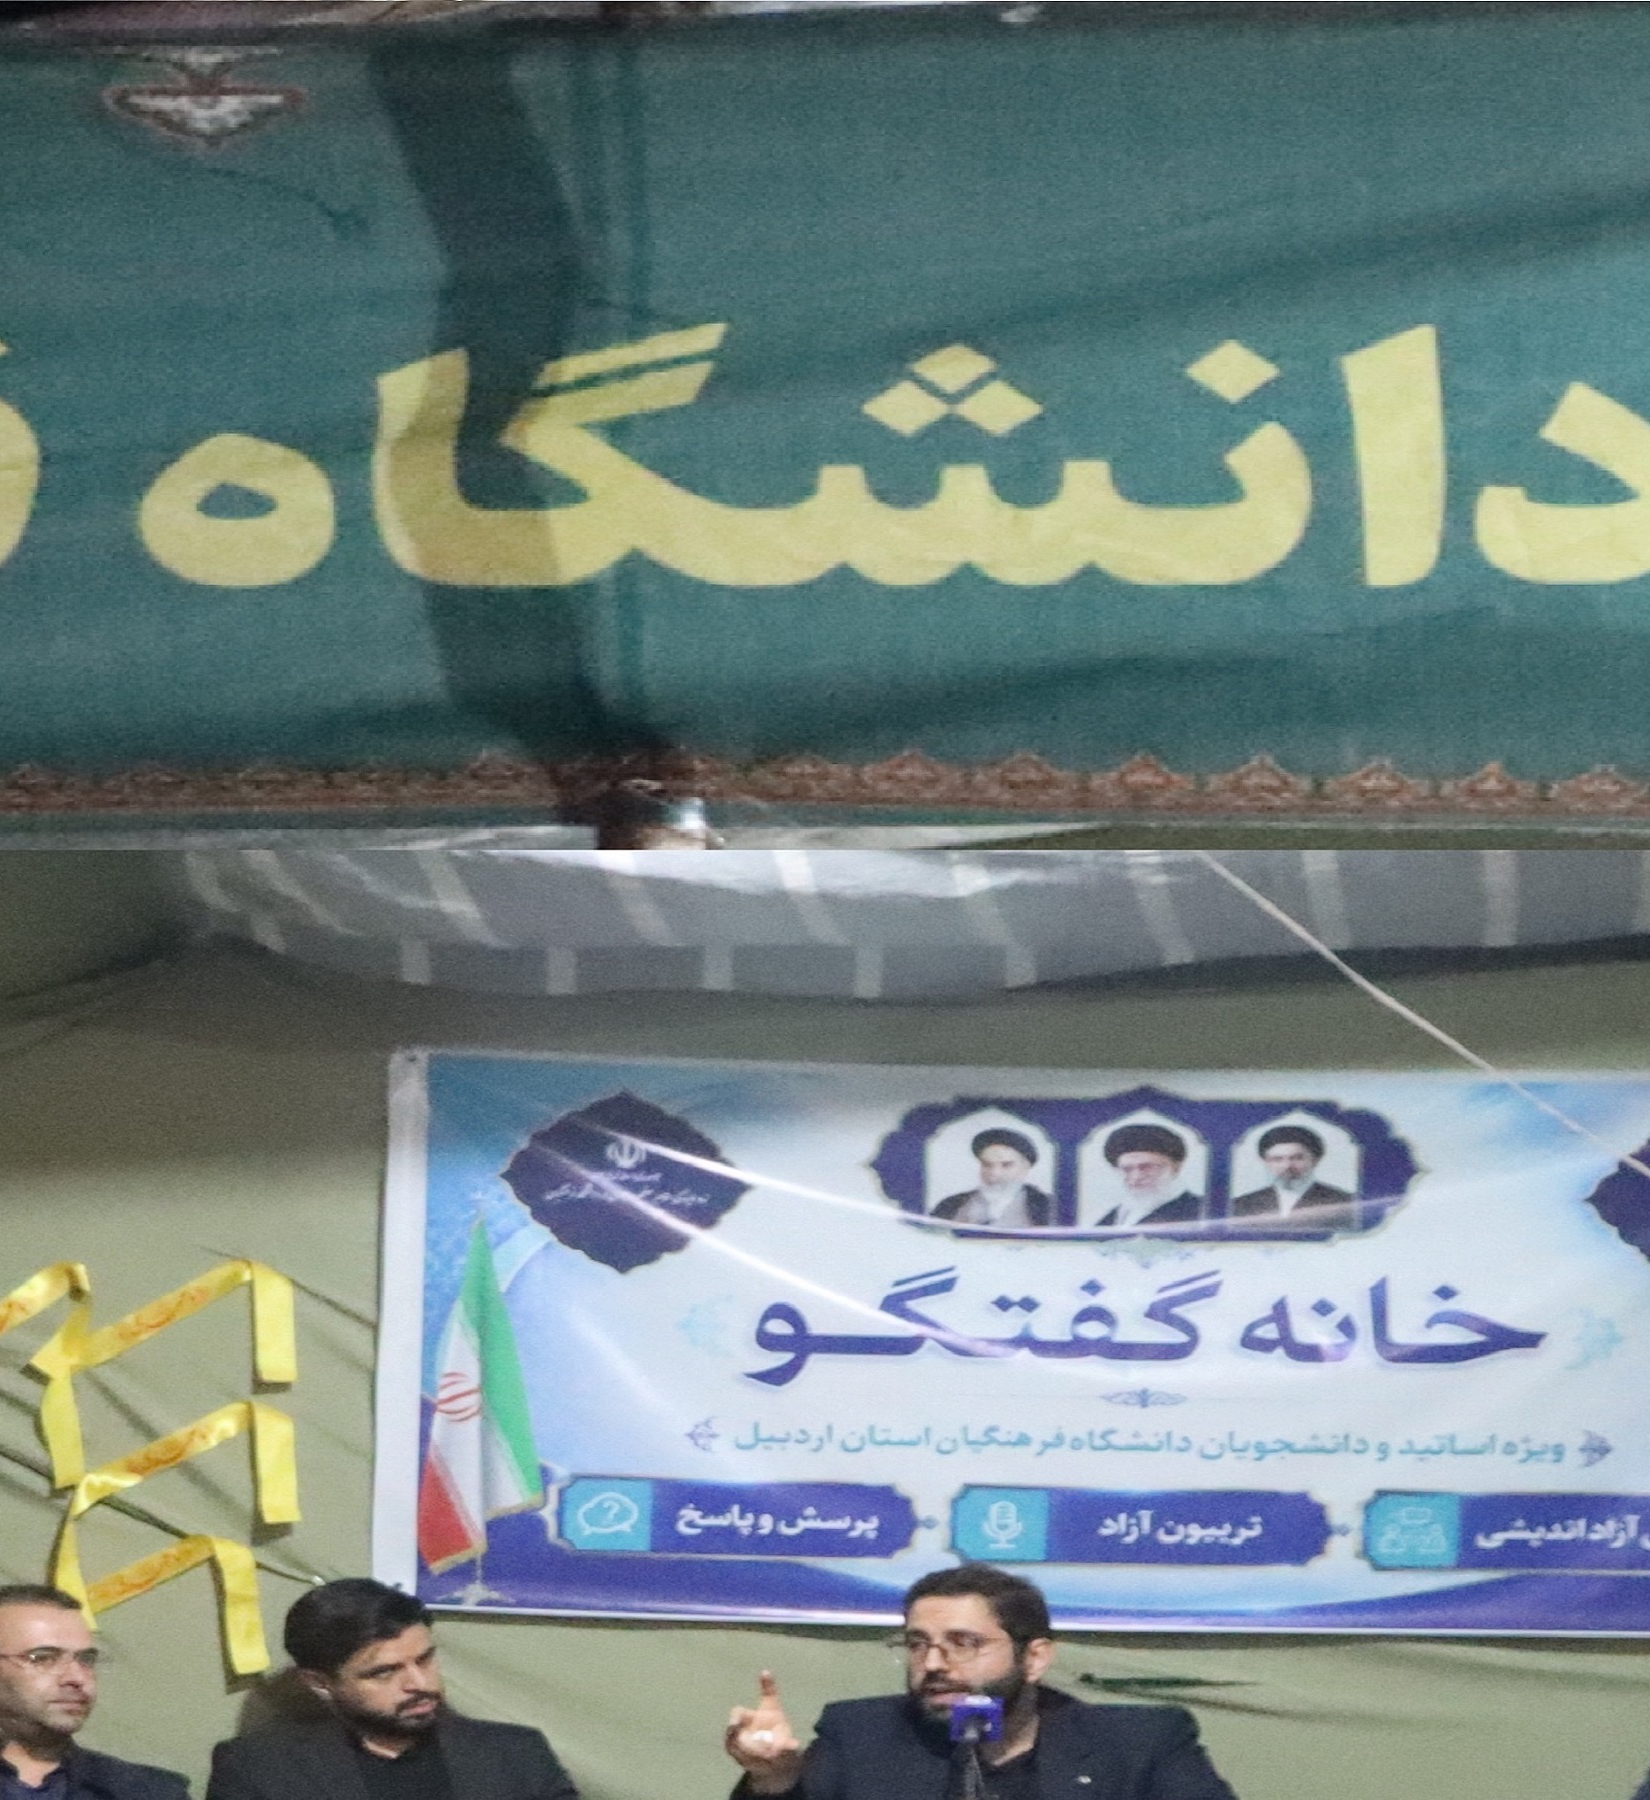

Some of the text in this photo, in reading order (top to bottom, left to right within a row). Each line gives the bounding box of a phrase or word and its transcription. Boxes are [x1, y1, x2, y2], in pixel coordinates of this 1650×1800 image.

[742, 1265, 1549, 1387] خانه گفتگو
[734, 1421, 1568, 1464] ویژه اساتید و دانشجویان دانشگاه فرهنگیان استان اردبیل
[777, 1504, 880, 1540] پرسش
[1097, 1509, 1264, 1547] تریبون آزاد
